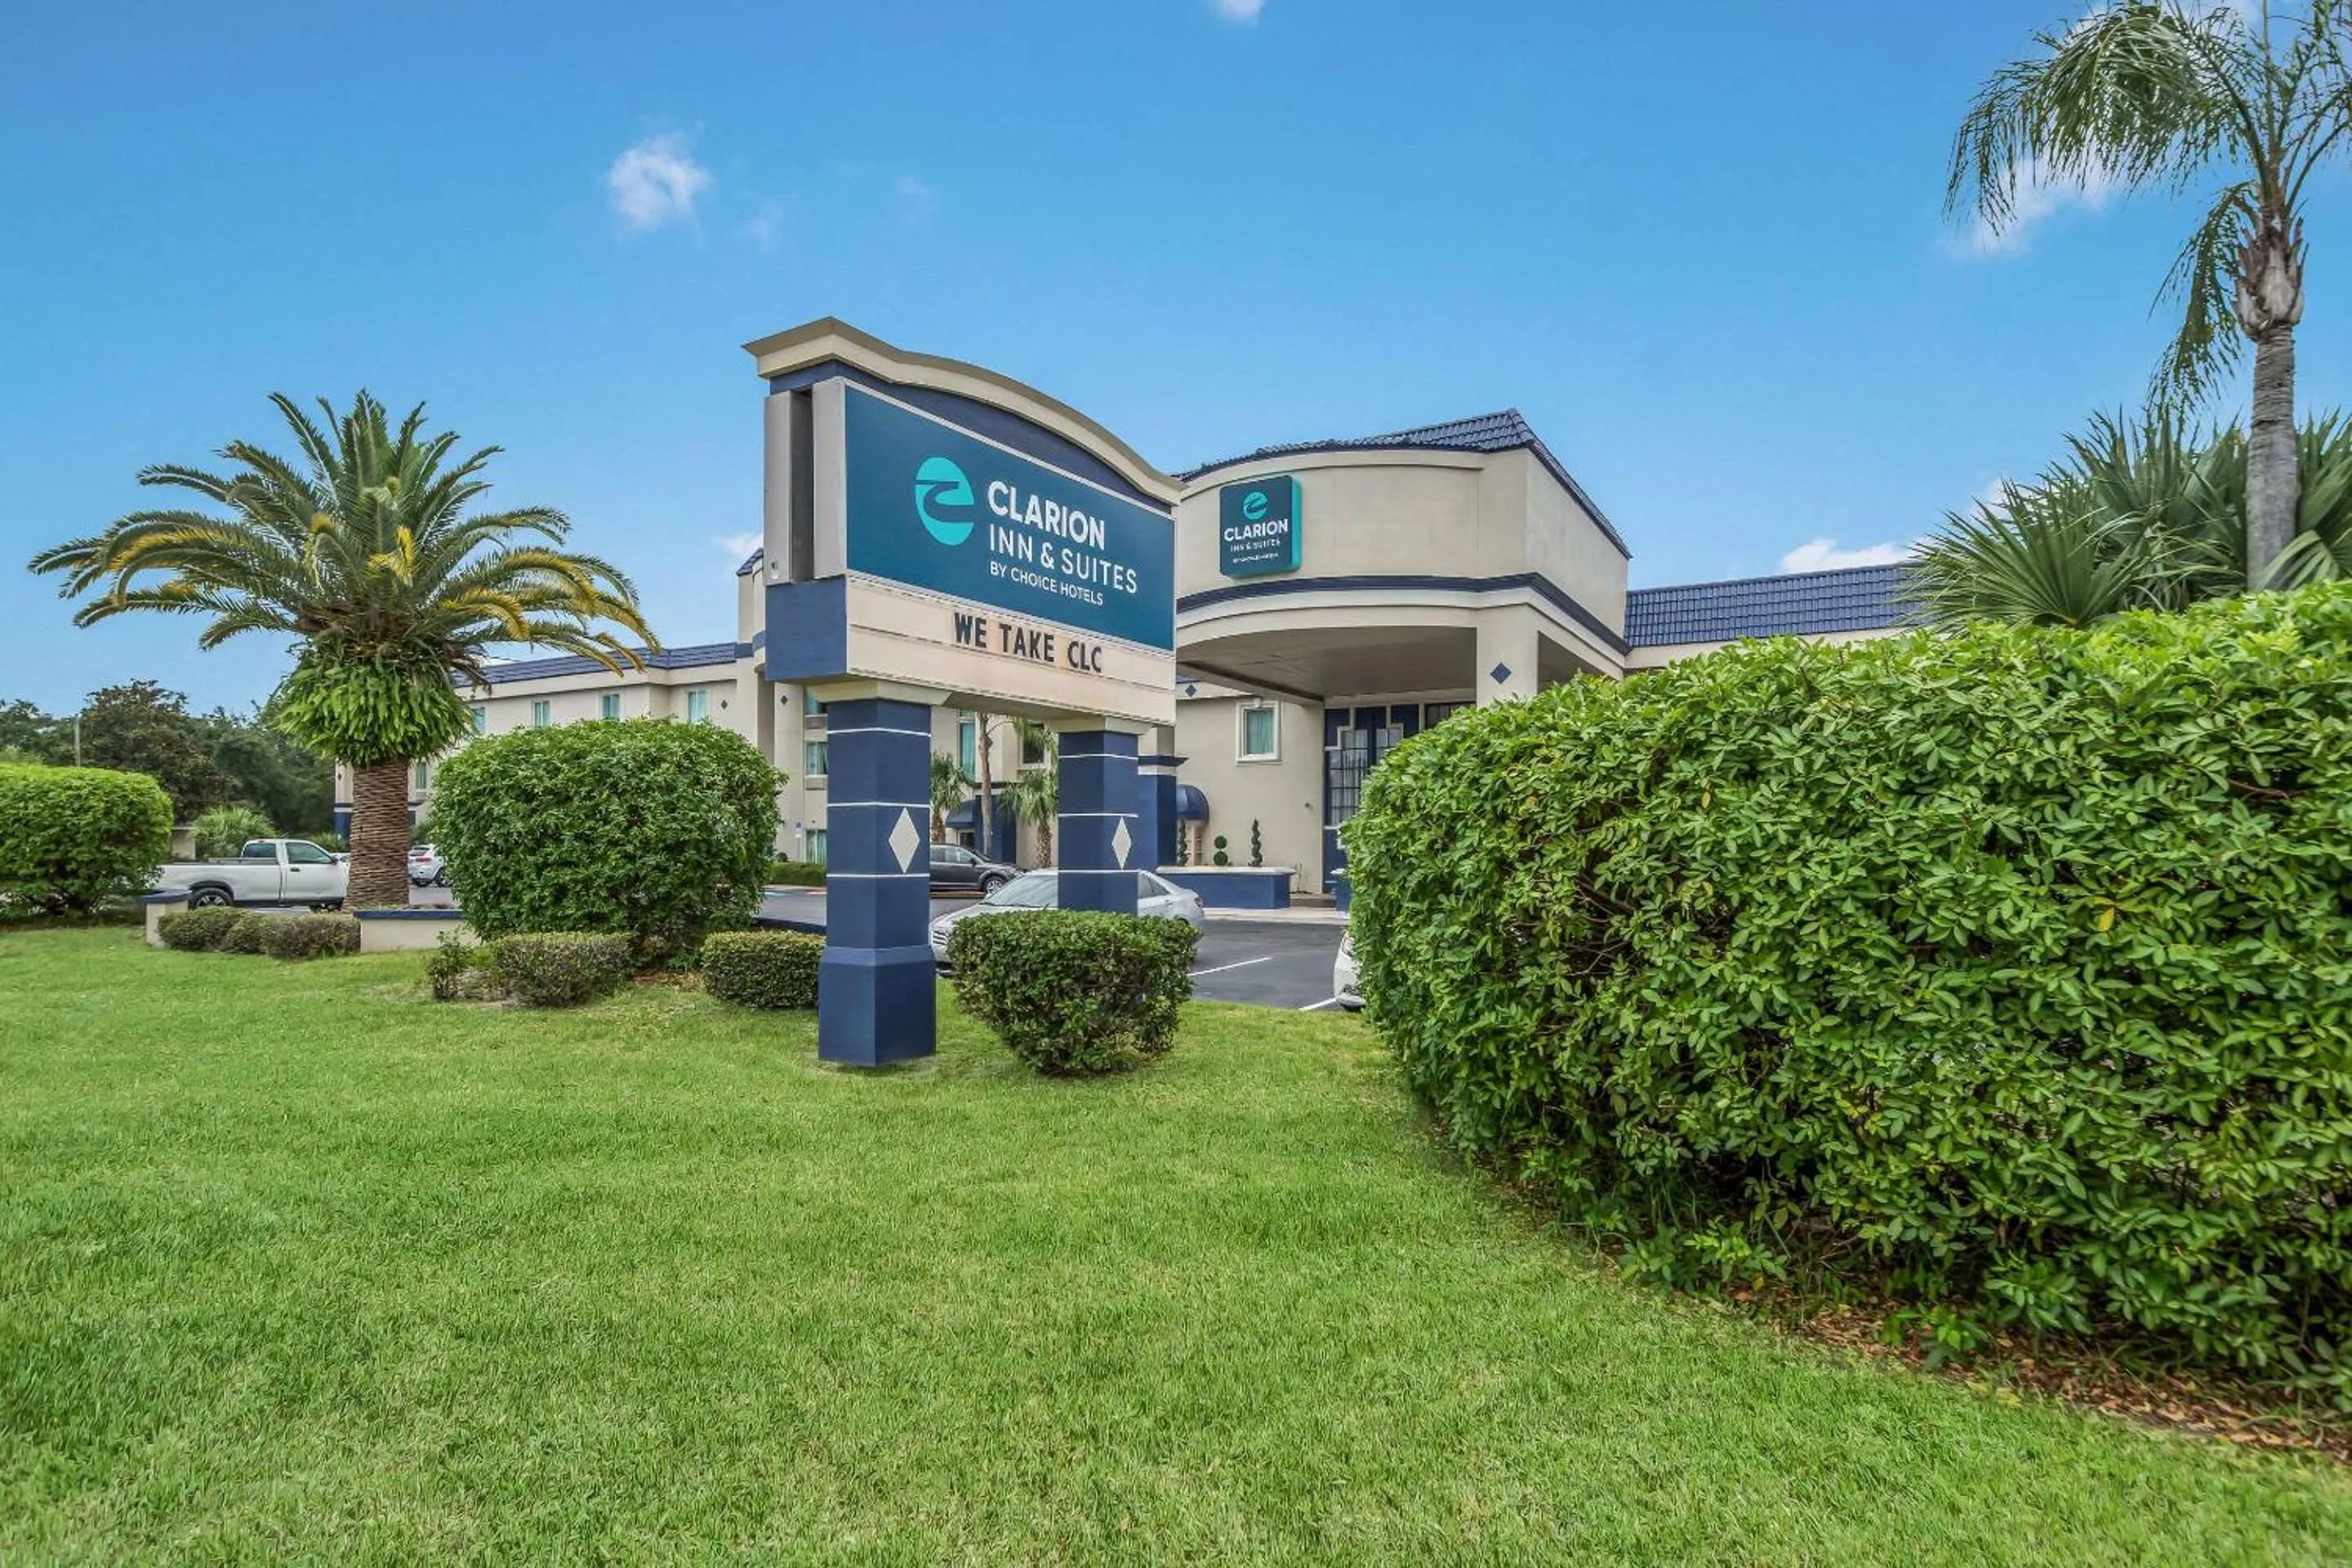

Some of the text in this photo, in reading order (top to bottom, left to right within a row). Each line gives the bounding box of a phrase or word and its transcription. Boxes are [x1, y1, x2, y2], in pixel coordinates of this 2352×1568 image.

[987, 480, 1105, 550] CLARION
[1224, 519, 1289, 541] CLARION
[989, 523, 1138, 595] INN & SUITES
[990, 561, 1104, 607] BY CHOICE HOTELS
[954, 612, 1102, 674] WE TAKE CLC
